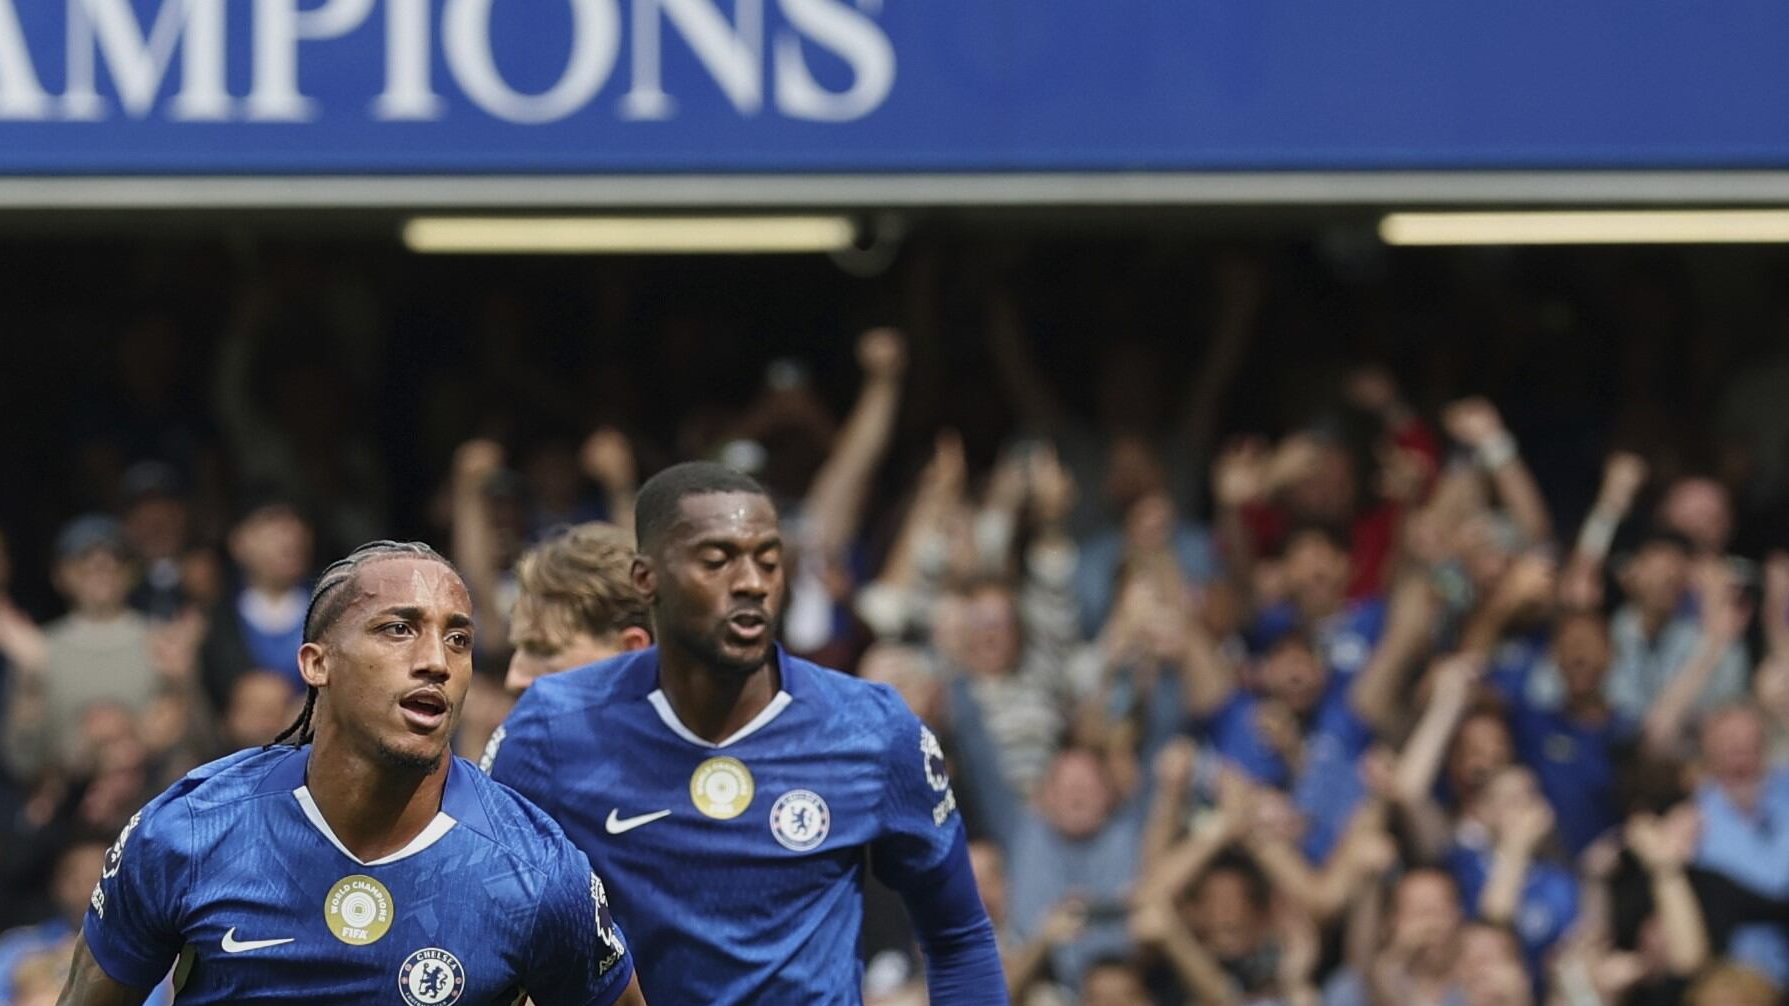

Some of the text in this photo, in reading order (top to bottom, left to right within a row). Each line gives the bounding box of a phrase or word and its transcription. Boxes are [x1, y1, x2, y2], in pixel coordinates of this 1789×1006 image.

[330, 880, 387, 922] WORLD CHAMPIONS
[342, 927, 369, 940] FIFA
[416, 950, 458, 970] CHELSEA
